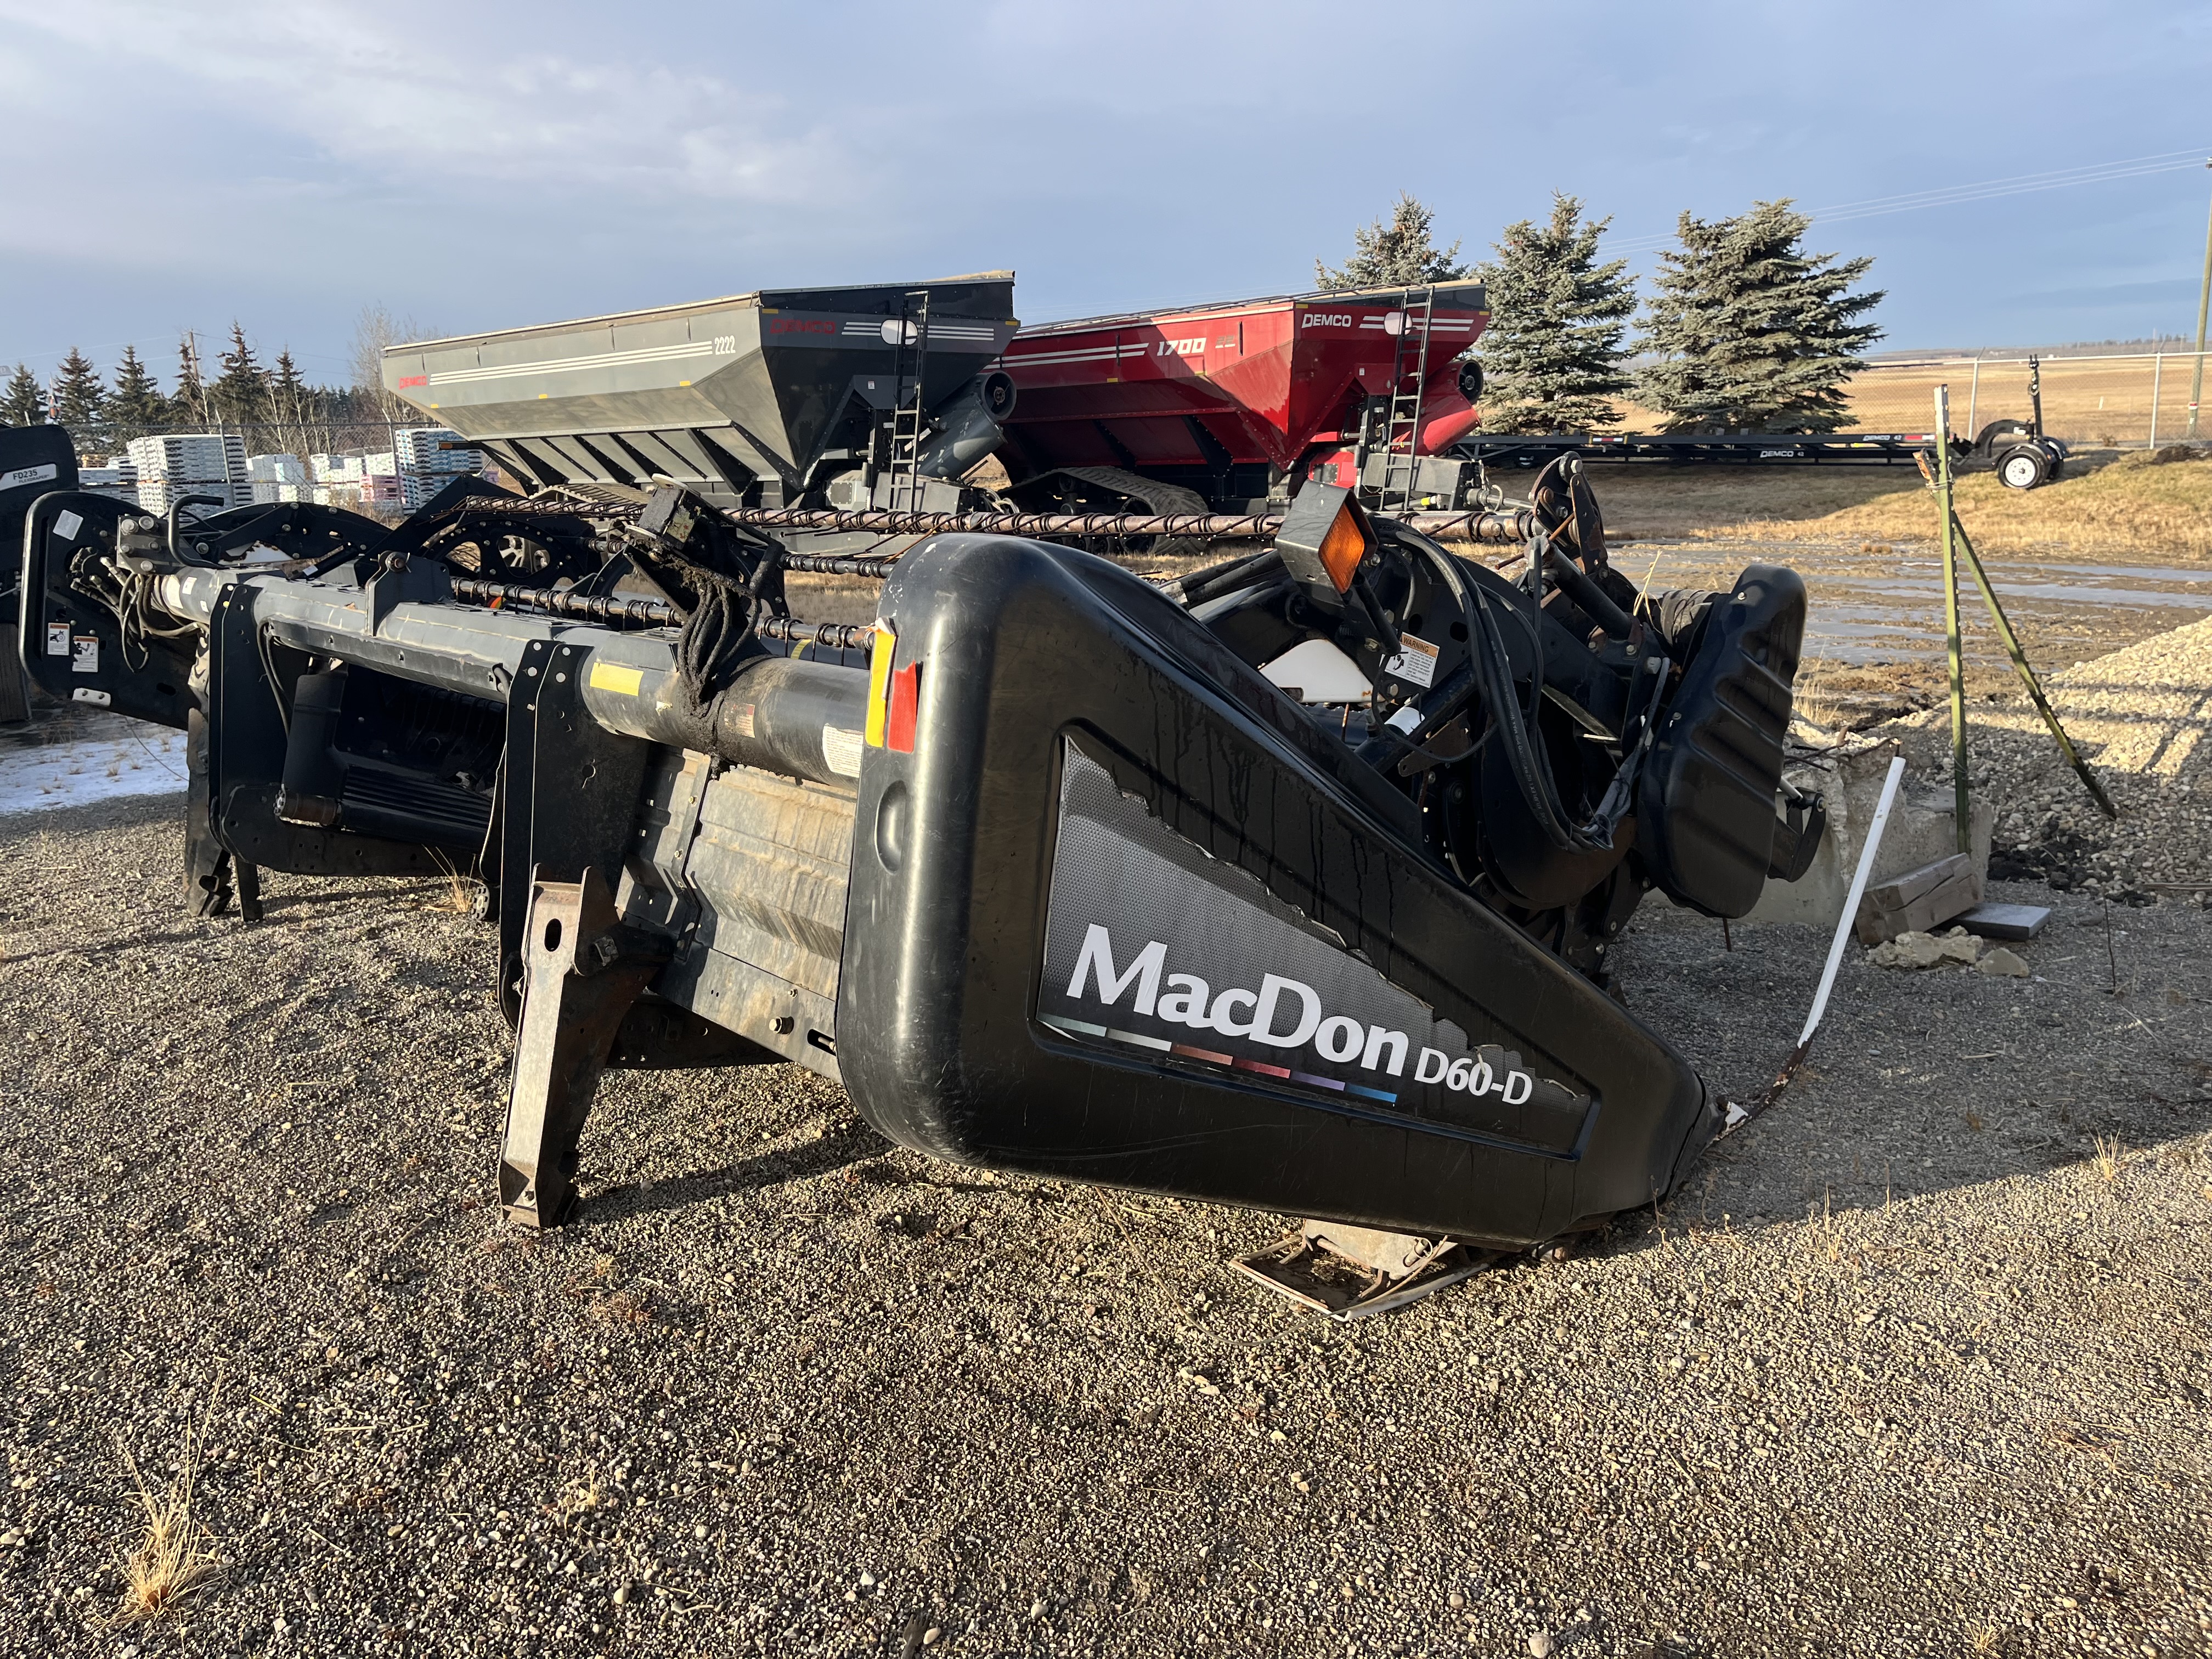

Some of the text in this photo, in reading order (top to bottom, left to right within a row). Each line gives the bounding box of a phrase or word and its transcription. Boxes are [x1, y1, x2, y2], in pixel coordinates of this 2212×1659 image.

[770, 319, 836, 334] DEMCO
[1301, 313, 1352, 329] DEMCO
[714, 335, 736, 355] 2222
[1156, 337, 1206, 356] 1700
[399, 376, 427, 390] DEMCO
[13, 469, 37, 480] FD235
[1403, 636, 1429, 653] WARNING
[1066, 923, 1533, 1105] MacDon D60-D
